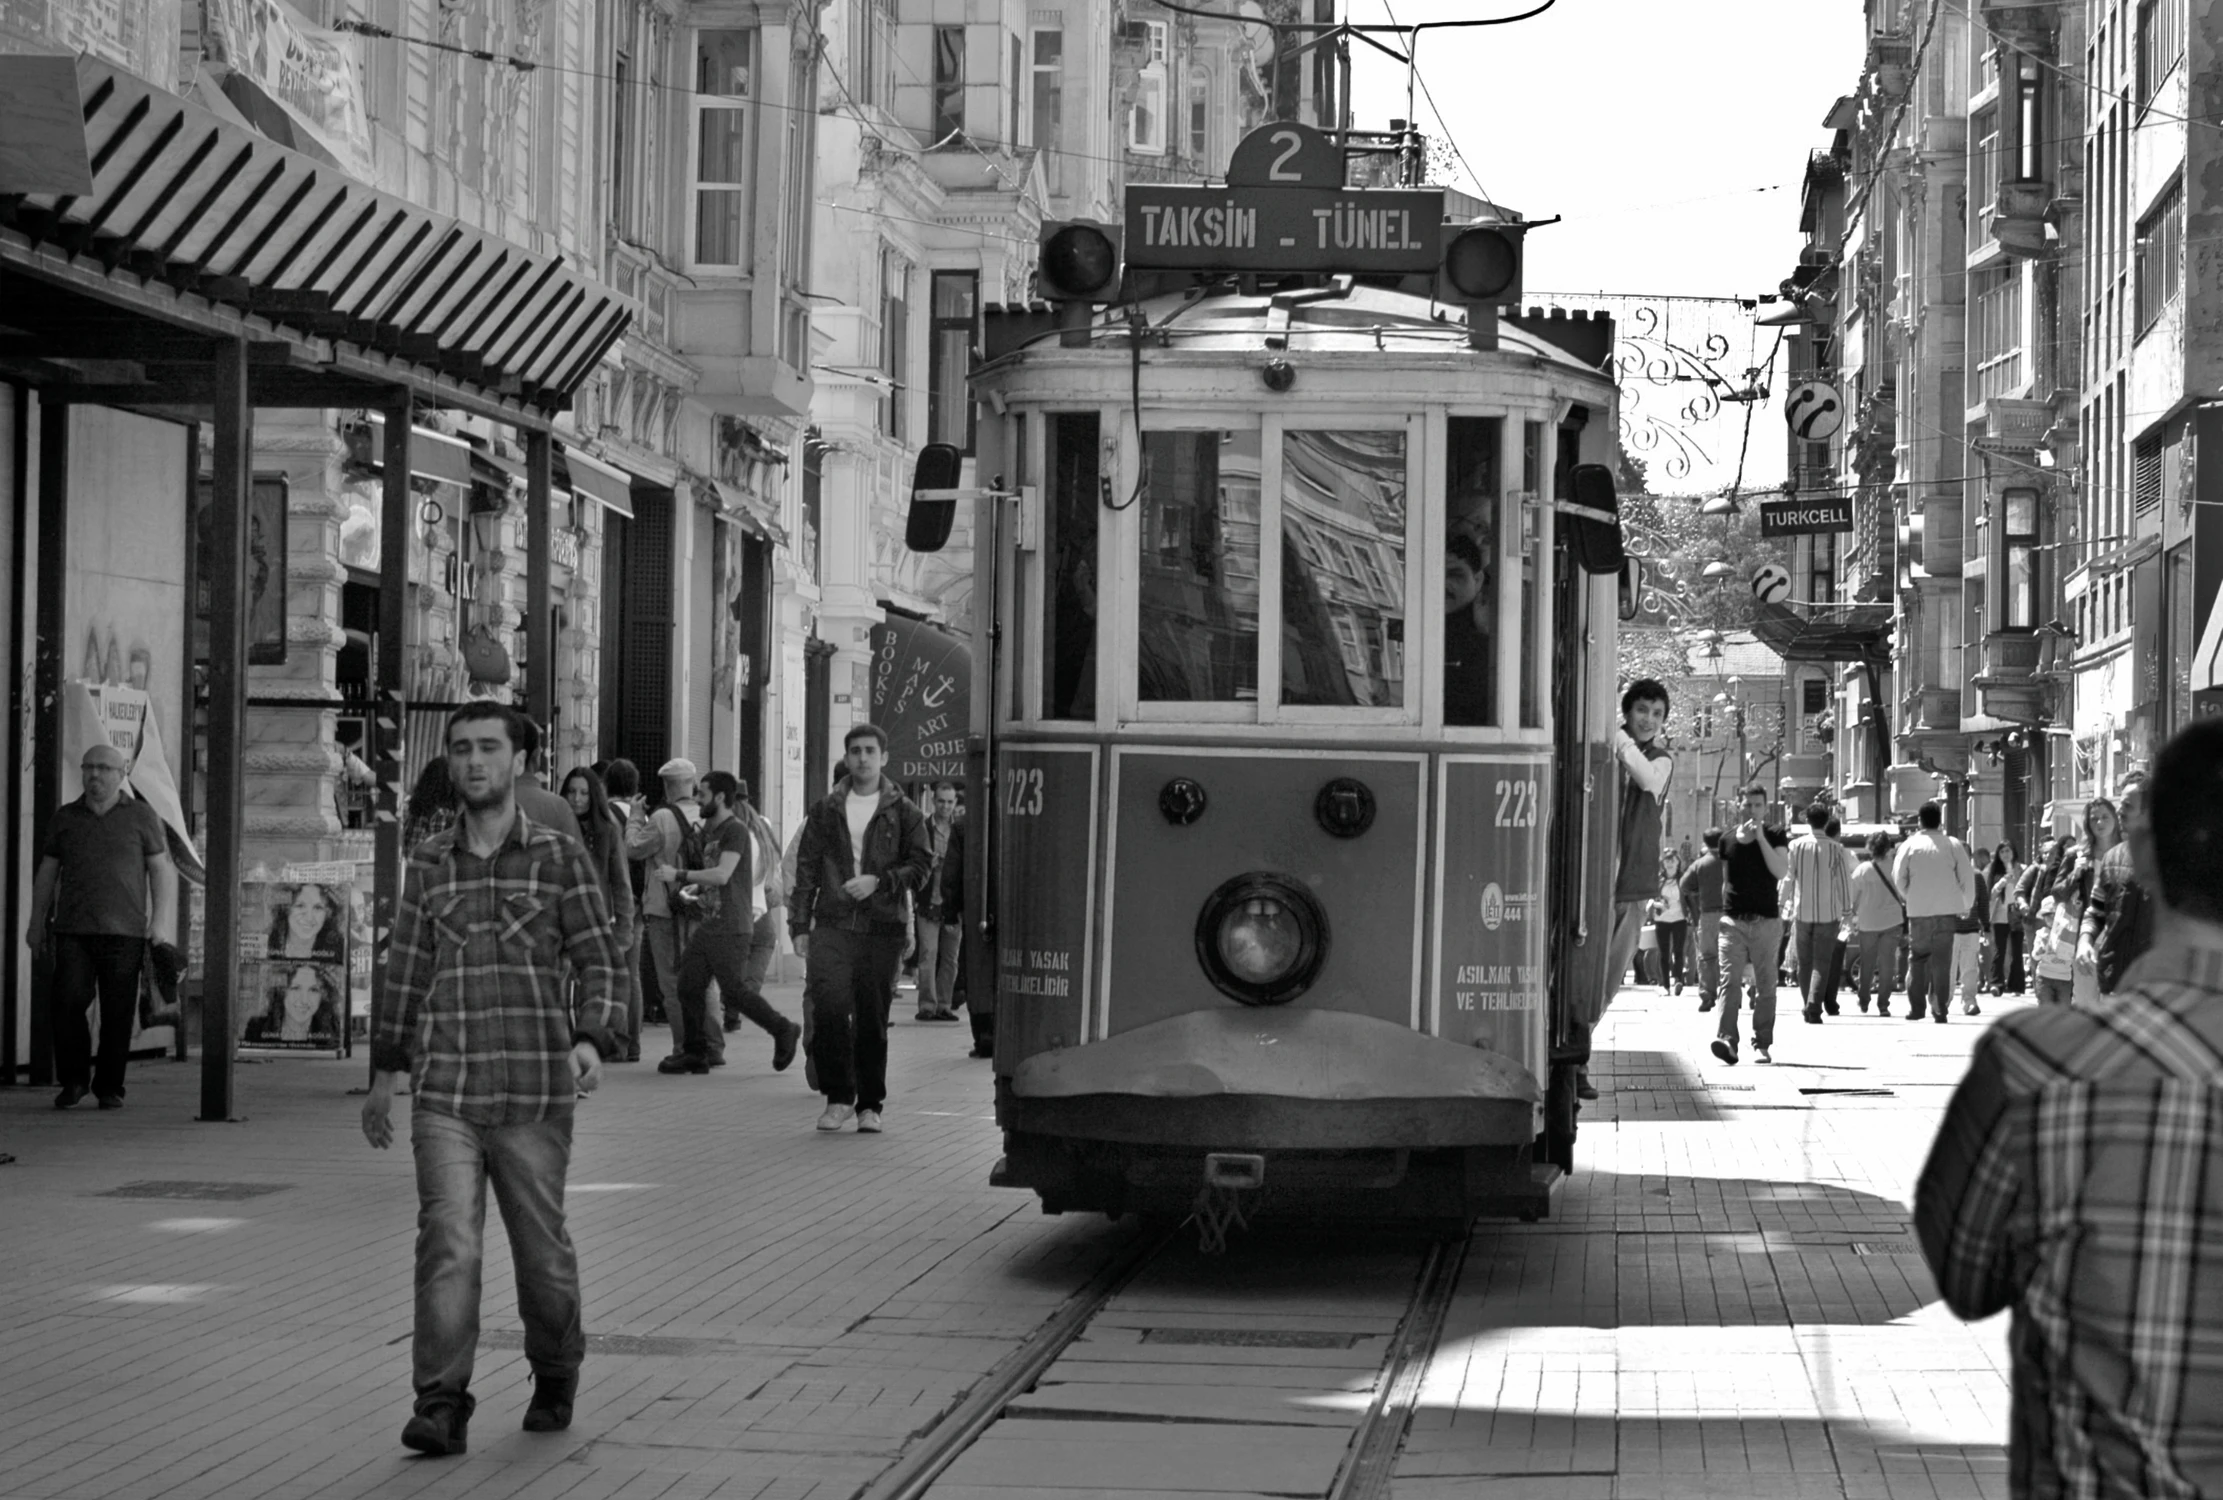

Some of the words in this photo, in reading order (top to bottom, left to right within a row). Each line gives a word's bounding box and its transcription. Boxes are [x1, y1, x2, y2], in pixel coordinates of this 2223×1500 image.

[1269, 130, 1302, 181] 2
[1140, 200, 1256, 248] TAKSİM
[1312, 202, 1422, 249] TÜNEL
[1766, 508, 1848, 527] TURKCELL
[874, 630, 897, 706] BOOKS
[894, 656, 931, 714] MAPS
[917, 712, 949, 740] ART
[920, 738, 966, 759] OBJE
[1007, 767, 1044, 816] 223
[1495, 779, 1537, 828] 223
[1030, 950, 1069, 971] YASAK
[1456, 965, 1512, 985] ASILMAK
[1456, 992, 1475, 1011] VE
